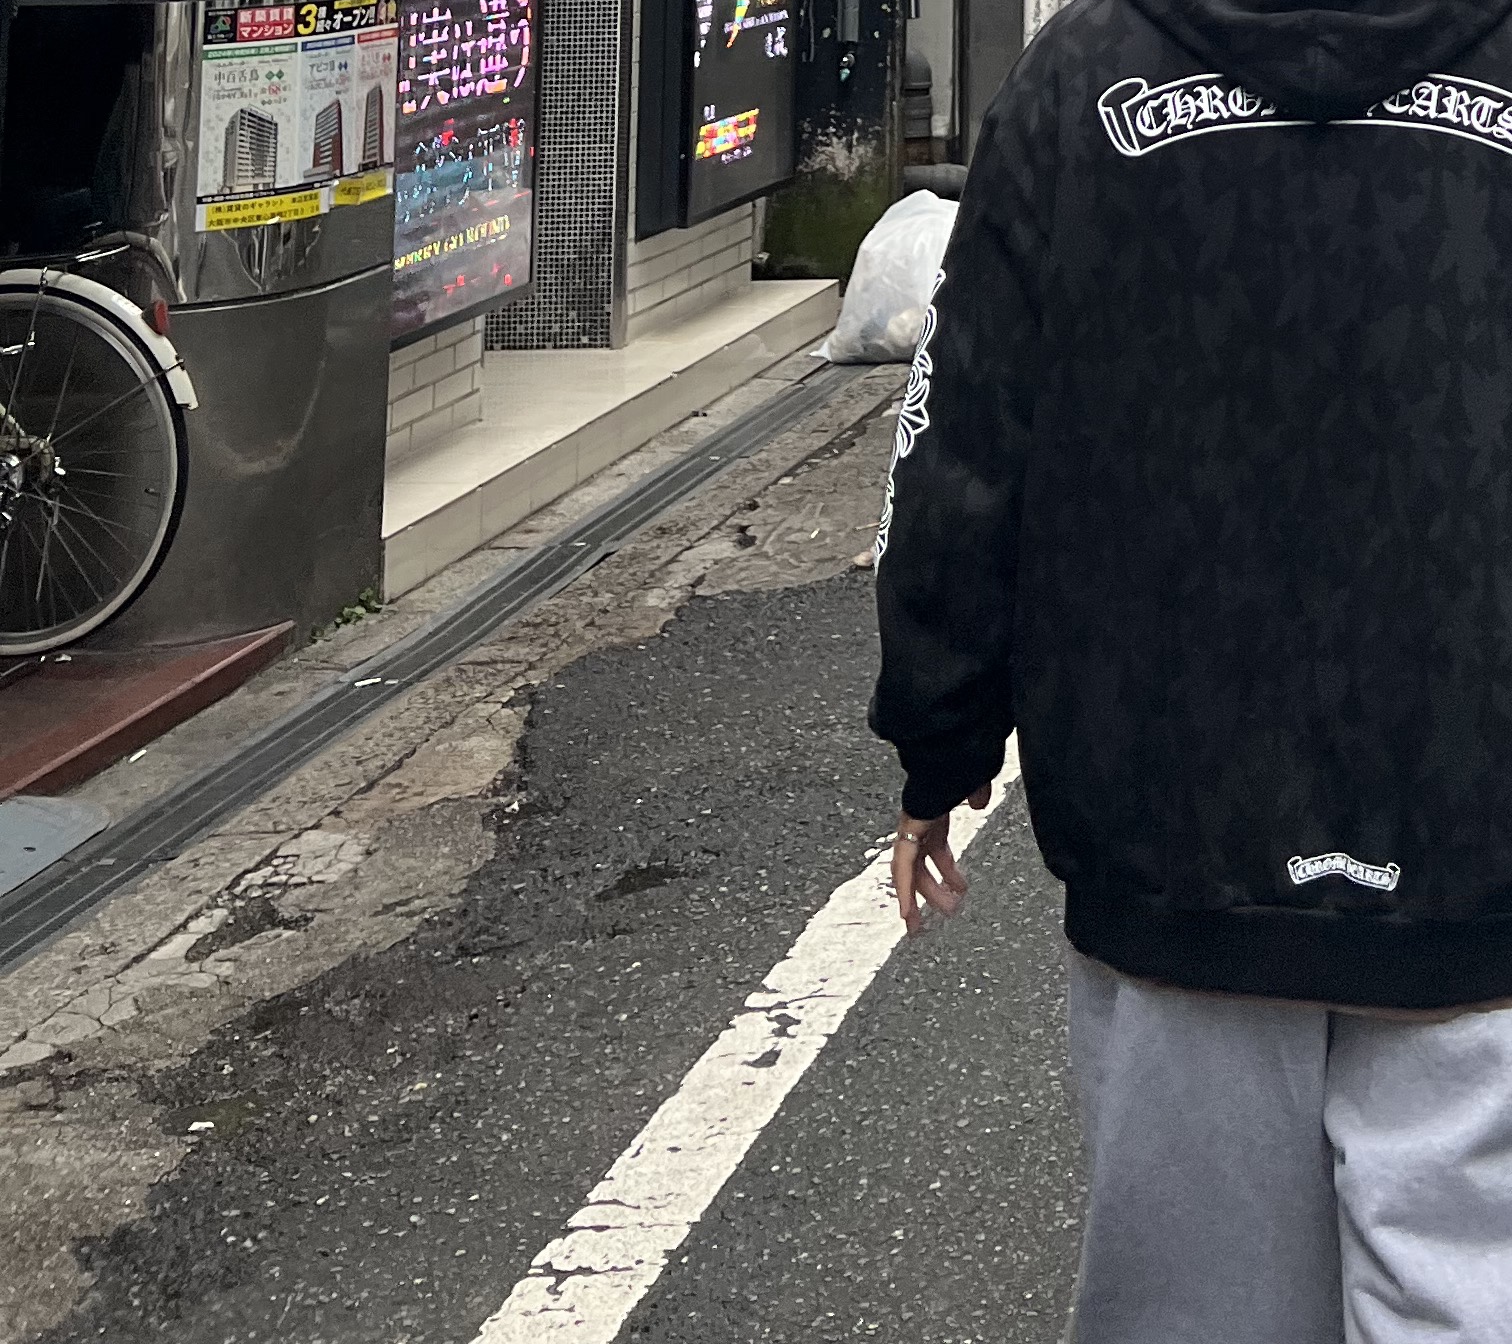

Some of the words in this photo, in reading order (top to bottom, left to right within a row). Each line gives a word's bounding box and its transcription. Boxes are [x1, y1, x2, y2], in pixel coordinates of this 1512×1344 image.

[239, 23, 294, 38] マンション
[296, 3, 318, 35] 3
